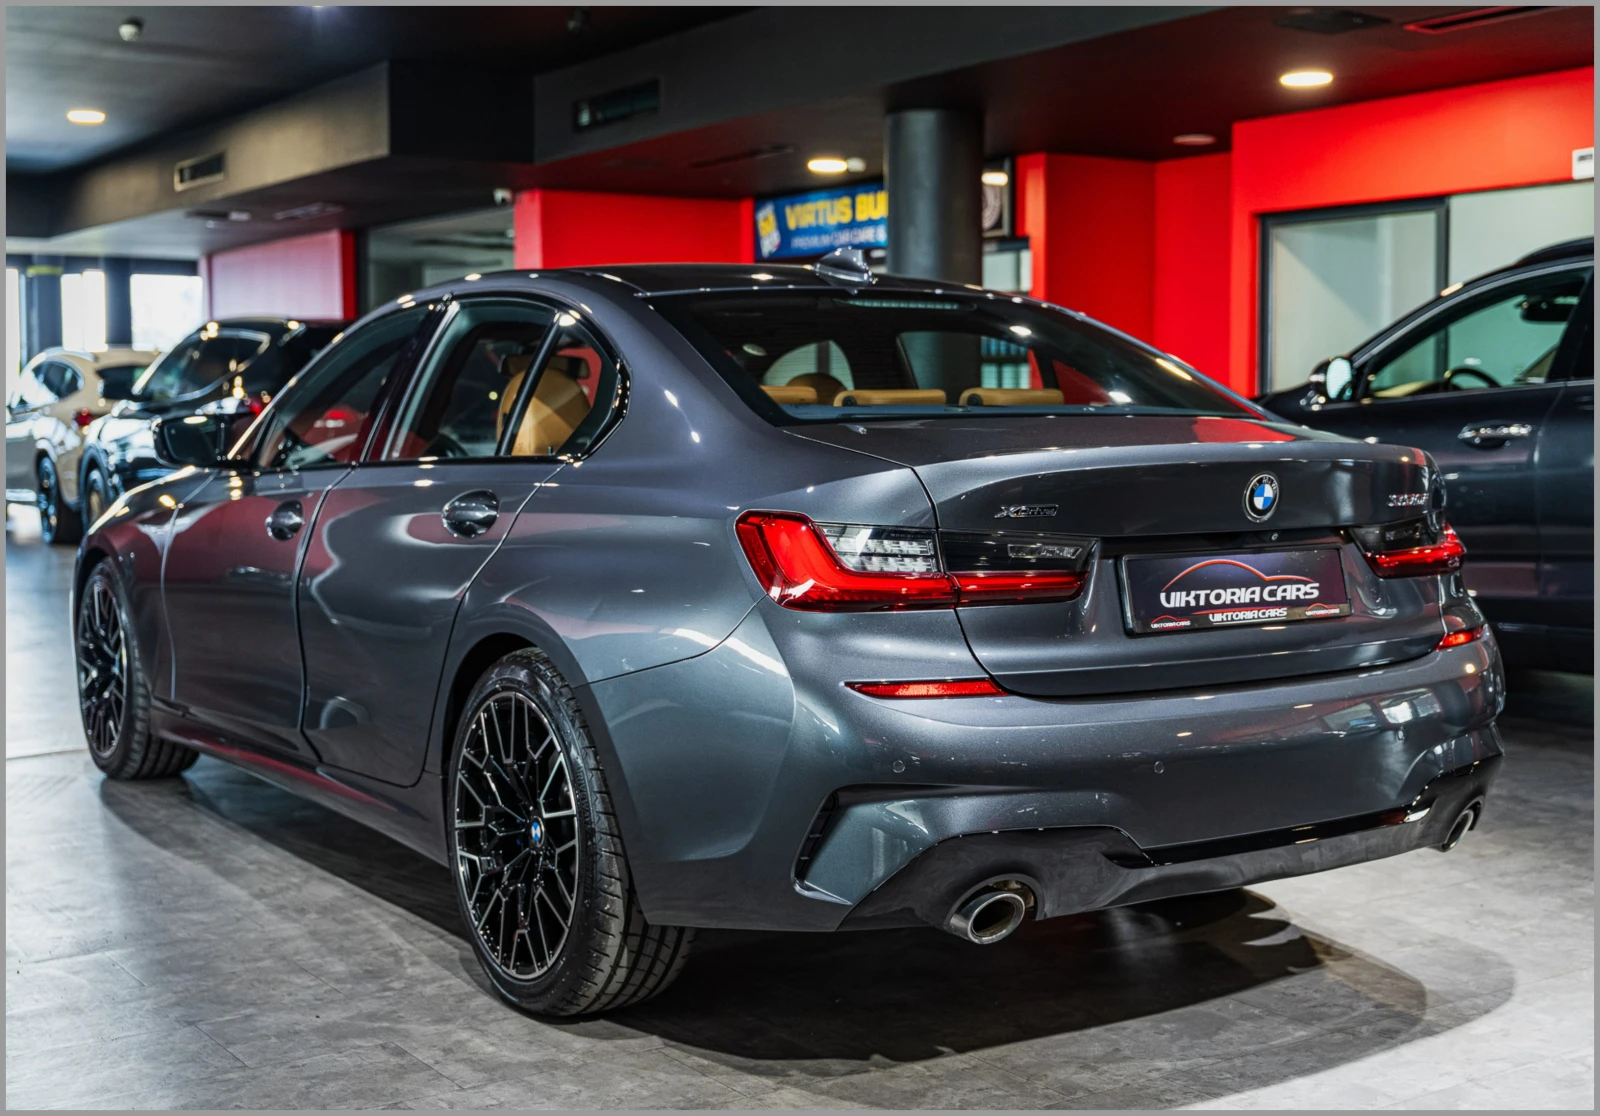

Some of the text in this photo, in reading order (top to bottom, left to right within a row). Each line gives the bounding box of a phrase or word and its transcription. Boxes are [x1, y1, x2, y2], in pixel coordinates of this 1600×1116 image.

[785, 196, 853, 231] VIRTUS
[1160, 583, 1320, 608] VIKTORIA CARS
[1209, 608, 1287, 622] VIKTORIA CARS
